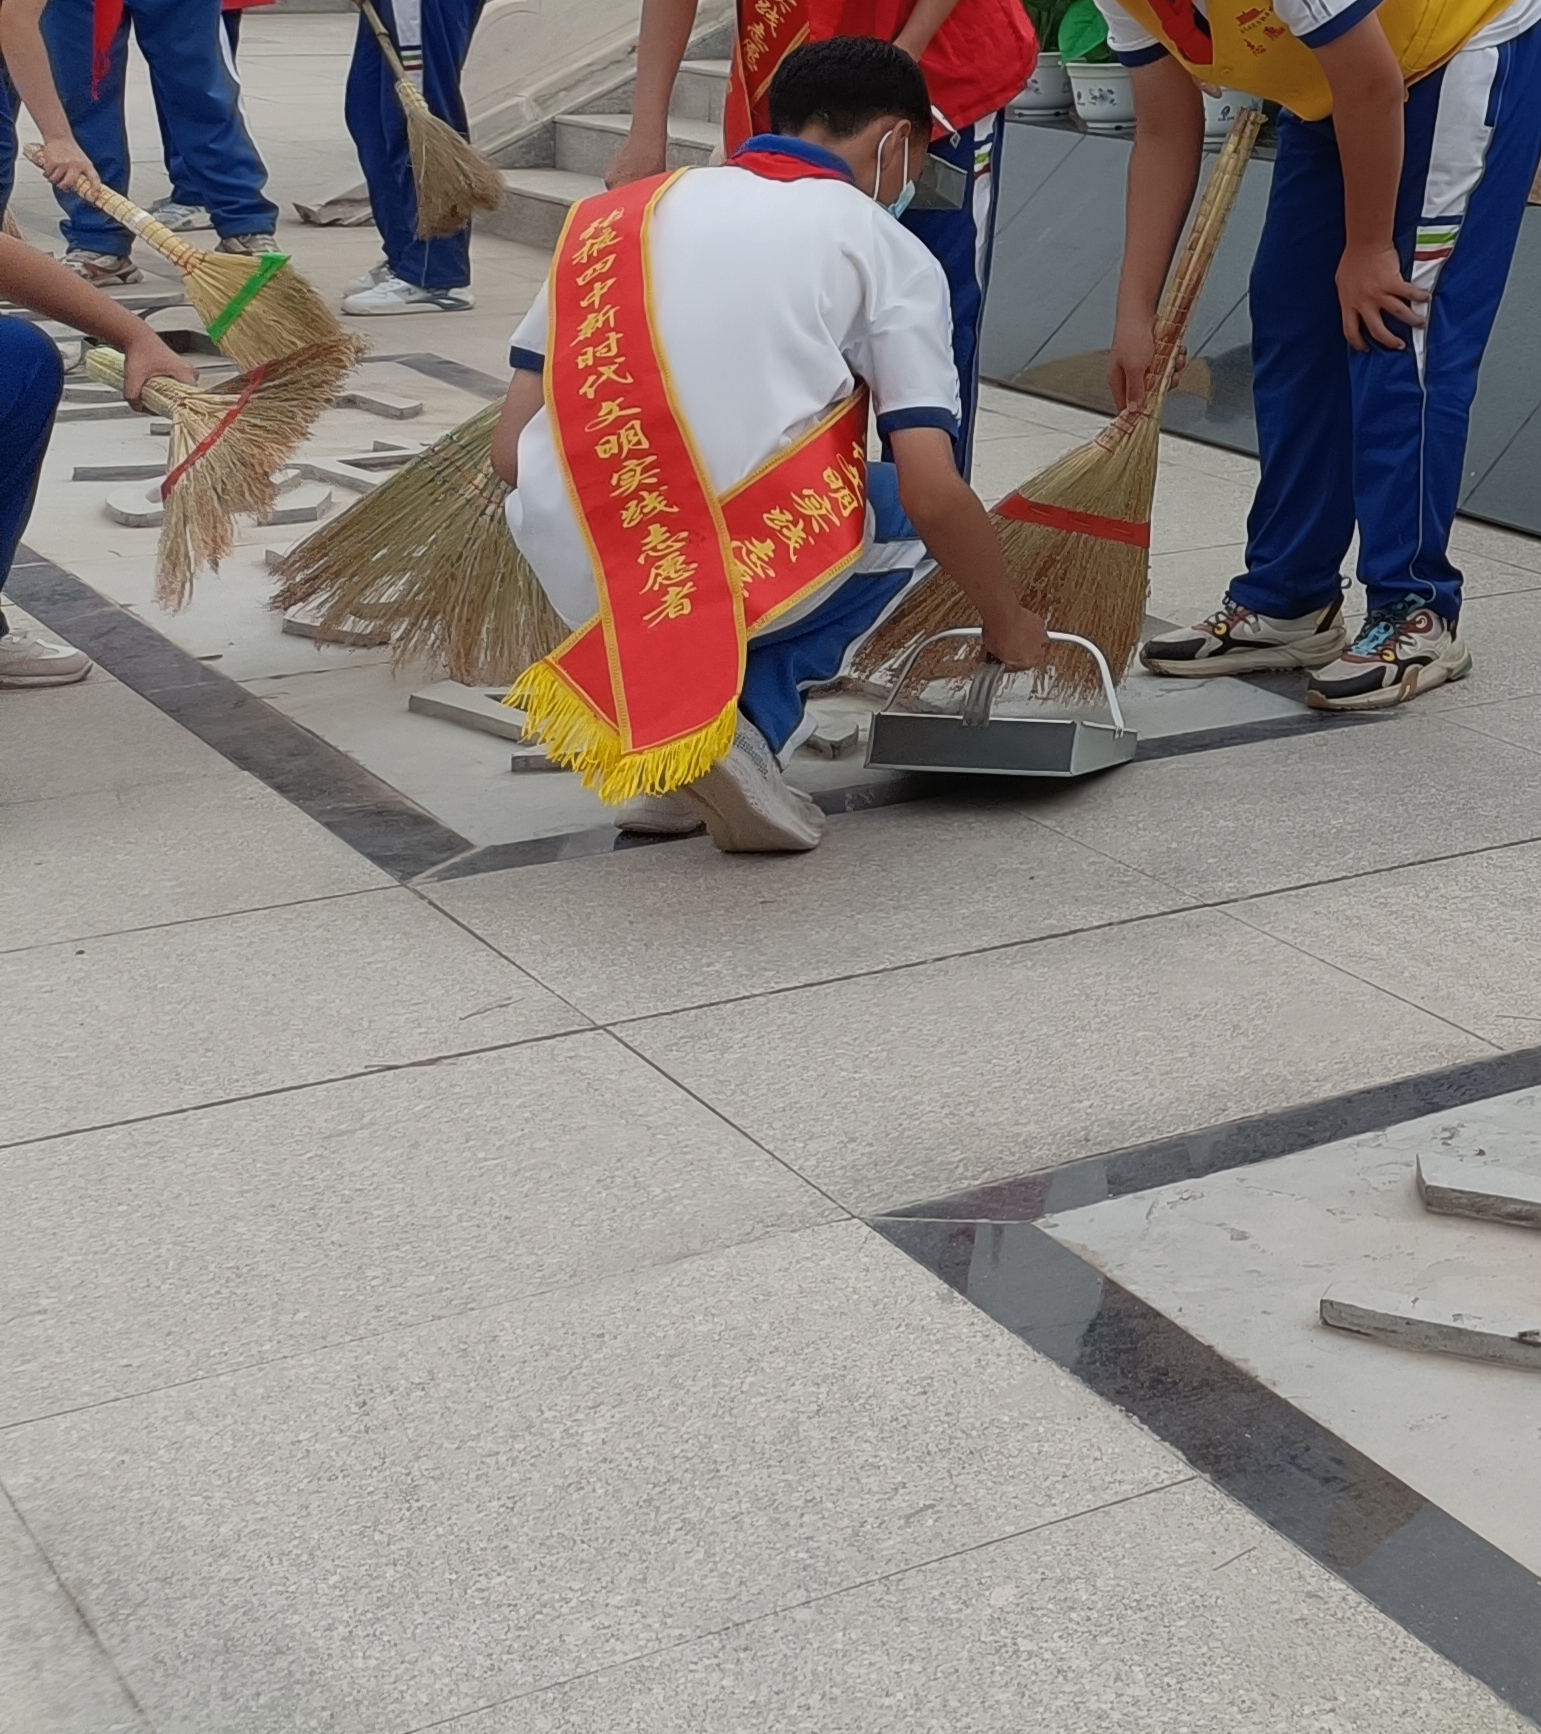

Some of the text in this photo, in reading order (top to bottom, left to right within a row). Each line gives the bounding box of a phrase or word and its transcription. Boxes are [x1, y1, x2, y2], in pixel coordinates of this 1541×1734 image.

[570, 207, 699, 628] 张掖四中新时代文明实践志愿者
